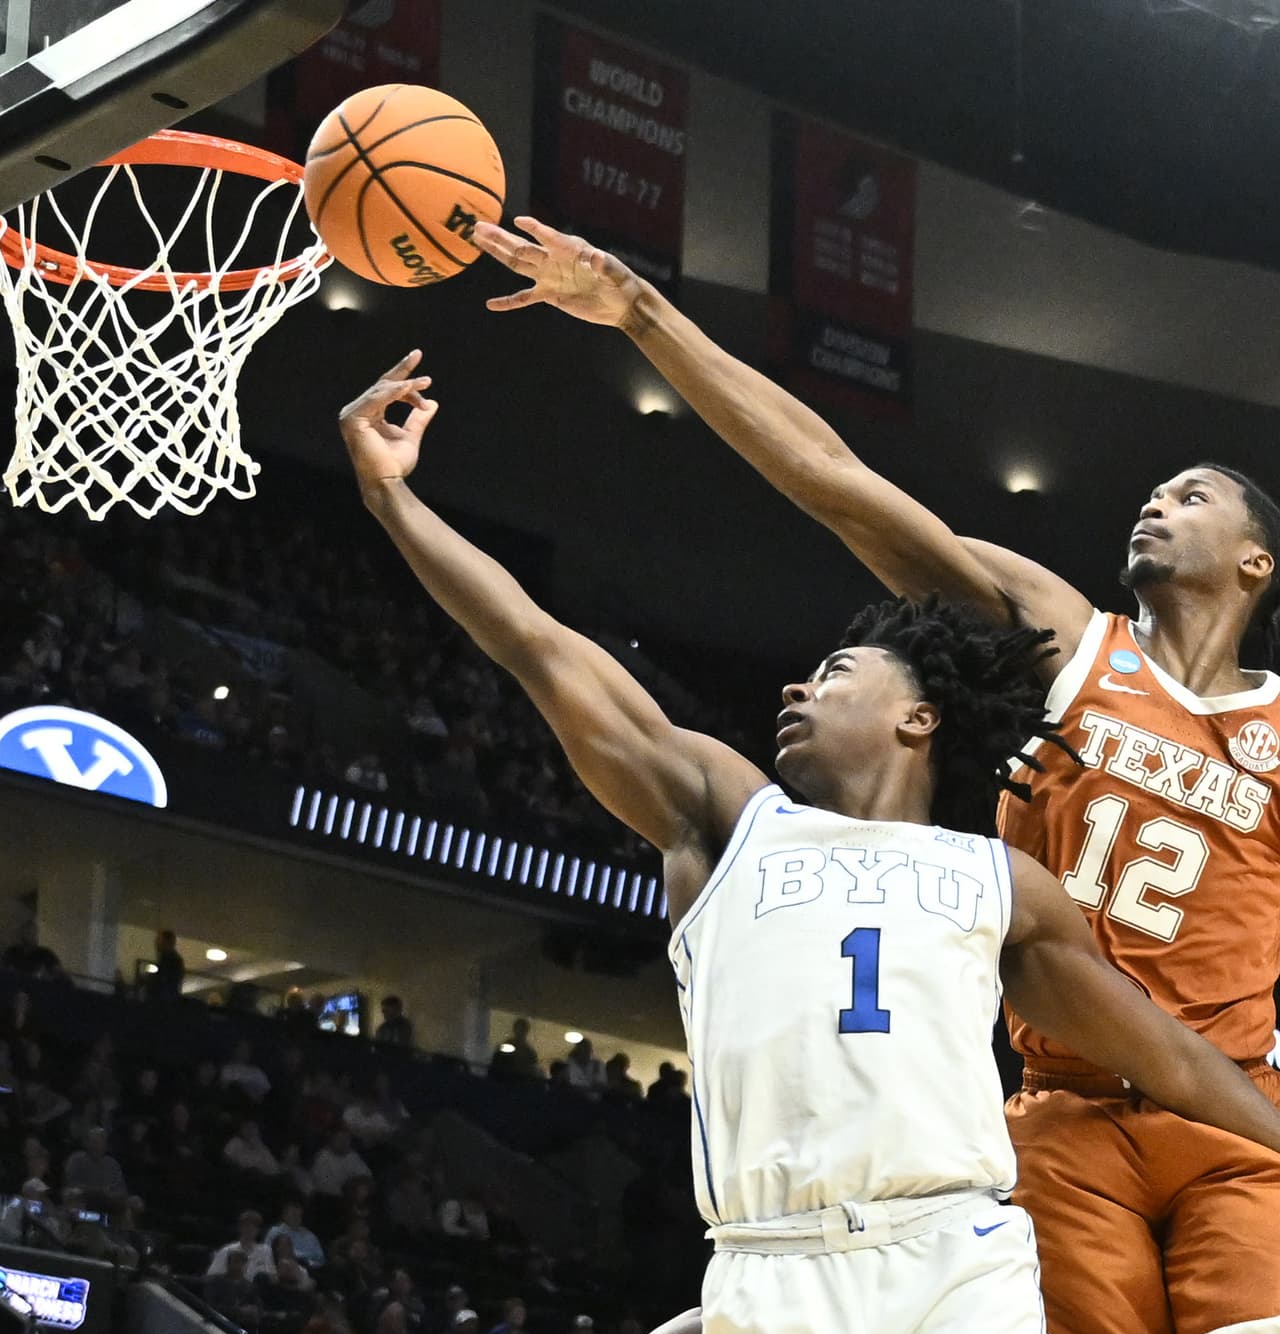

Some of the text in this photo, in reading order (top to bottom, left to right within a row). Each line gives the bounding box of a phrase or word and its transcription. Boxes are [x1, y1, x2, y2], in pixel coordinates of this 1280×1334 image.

[563, 86, 685, 156] CHAMPIONS
[589, 58, 664, 108] WORLD
[581, 156, 663, 210] 1976-77
[1079, 709, 1273, 835] TEXAS
[1240, 722, 1278, 760] SEC
[756, 846, 985, 933] BYU
[1060, 793, 1210, 944] 12
[838, 926, 891, 1035] 1
